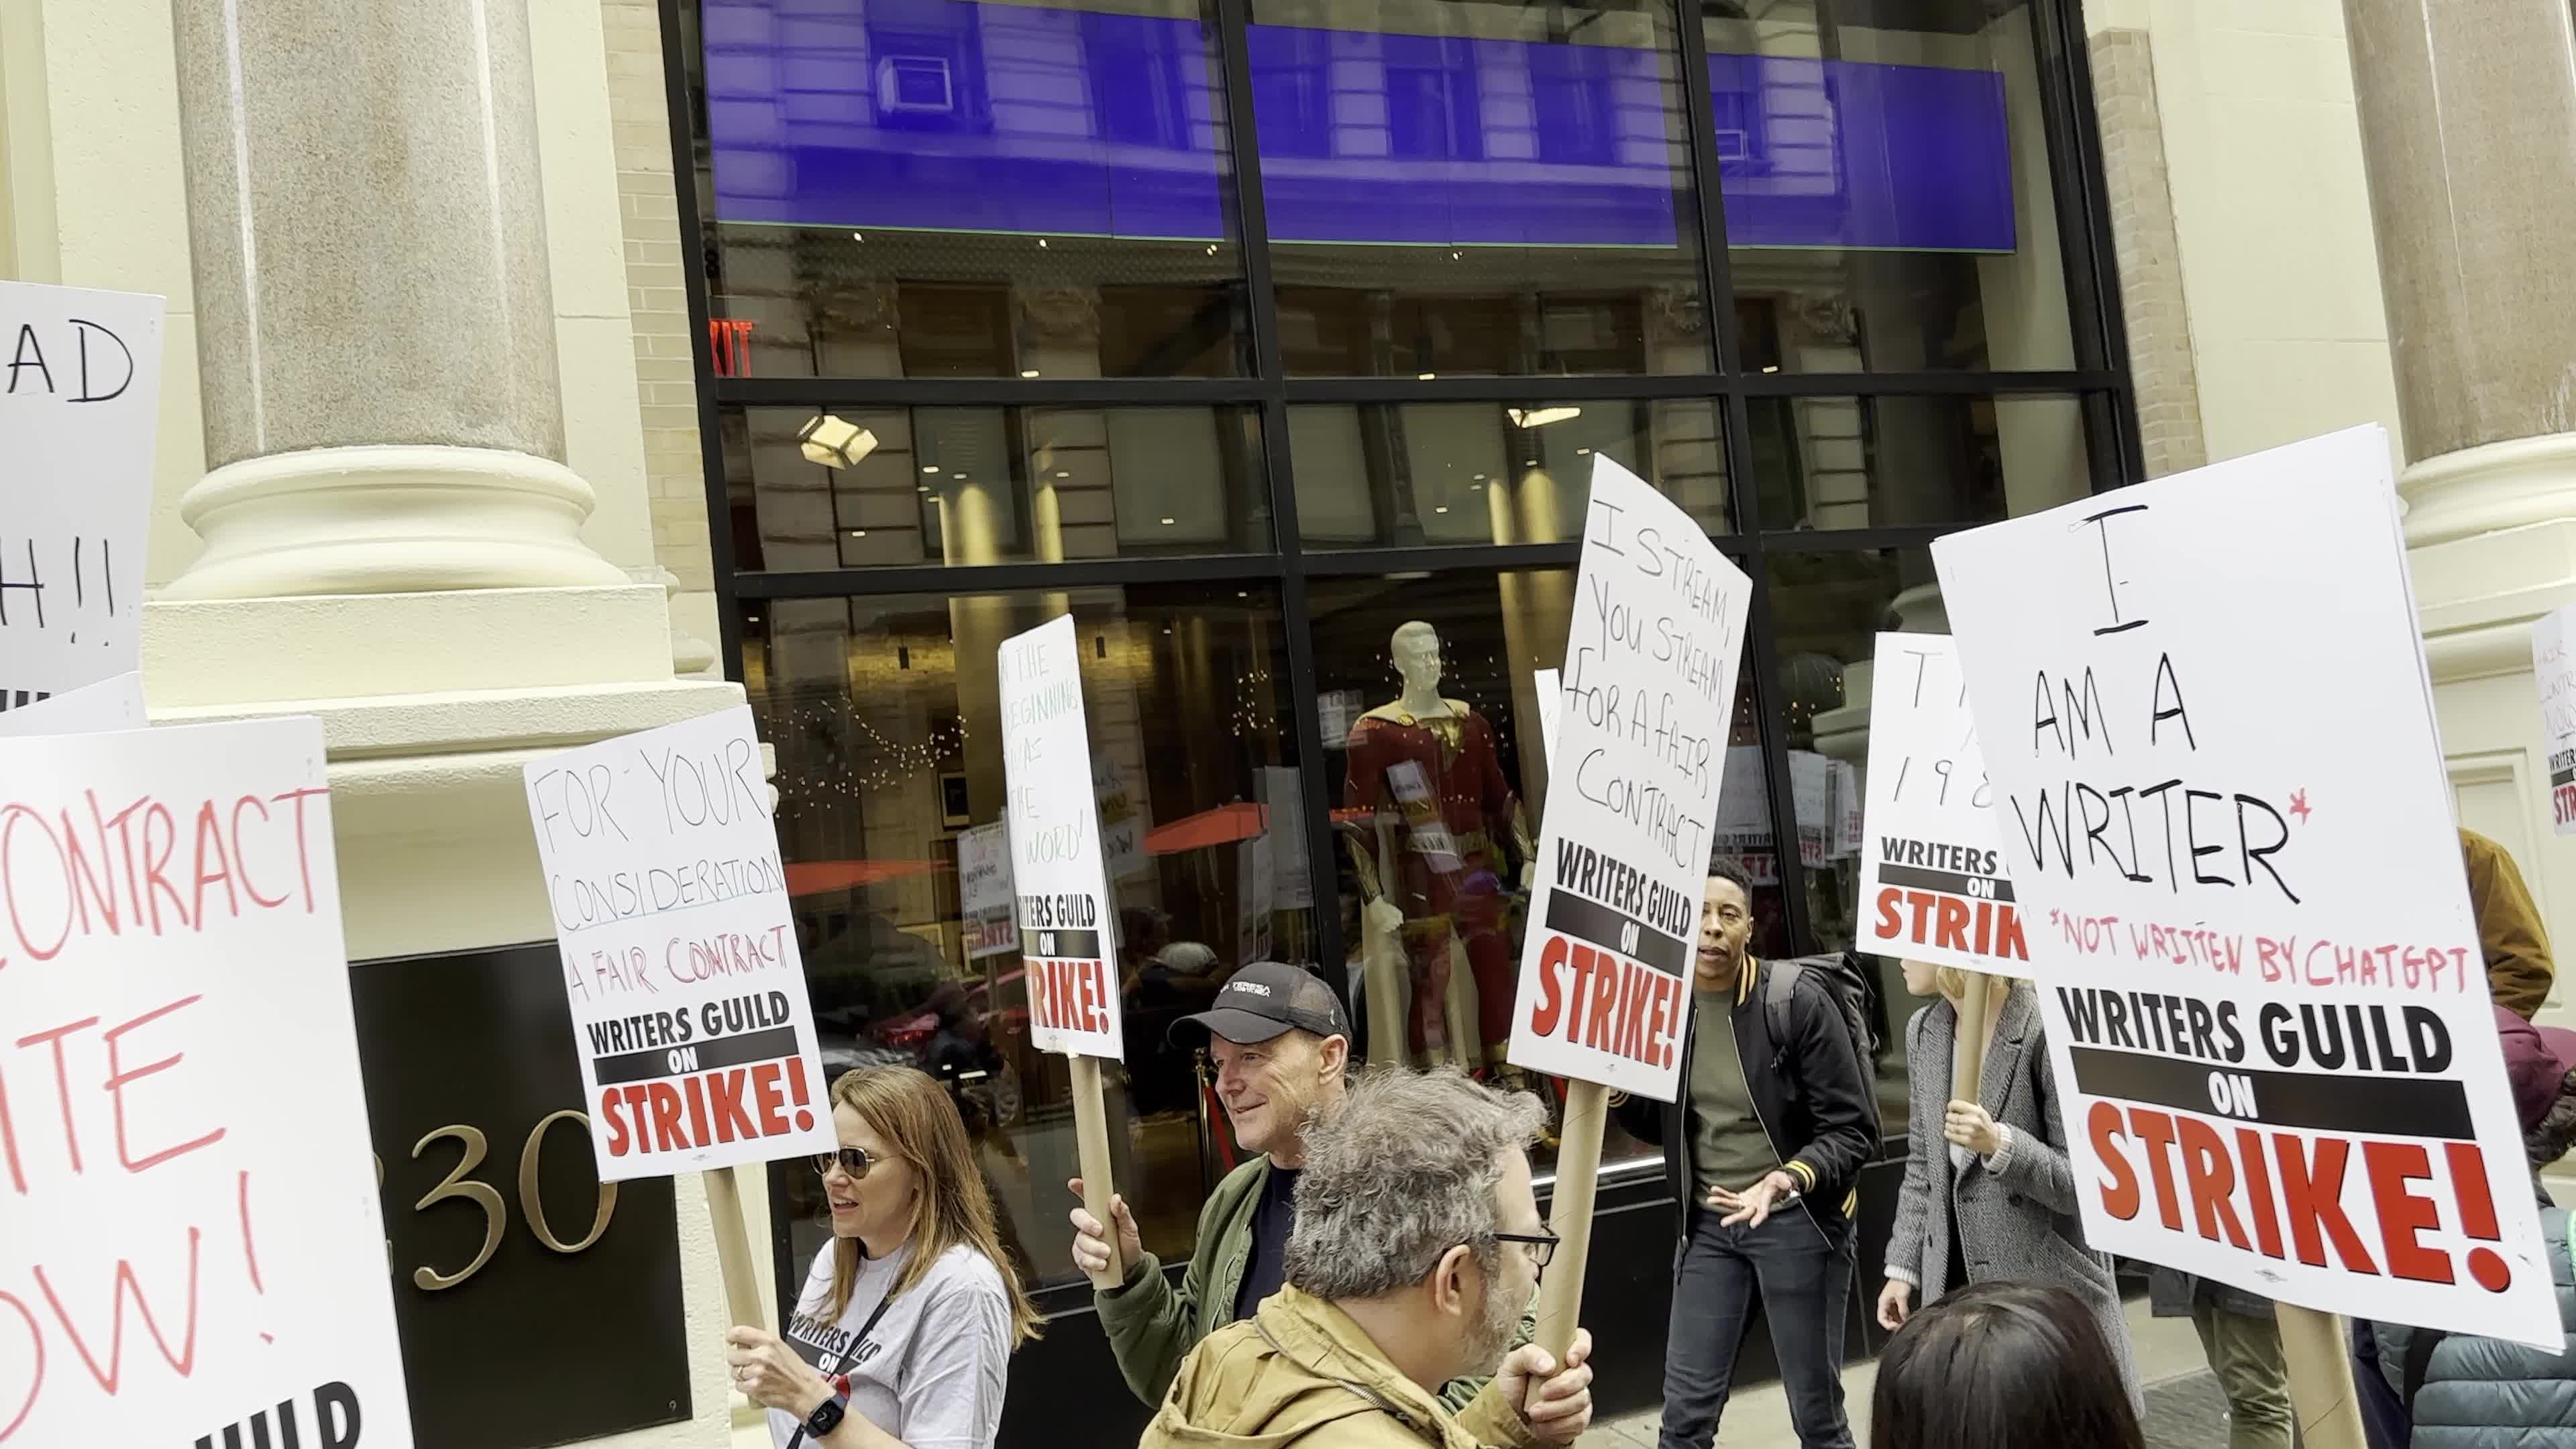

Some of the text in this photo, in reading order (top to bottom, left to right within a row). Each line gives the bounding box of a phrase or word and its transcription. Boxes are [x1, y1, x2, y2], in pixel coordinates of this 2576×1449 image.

[1591, 498, 1625, 557] I
[2069, 504, 2148, 635] I
[1590, 573, 1643, 661] YOU
[1631, 688, 1647, 747] A
[2033, 651, 2197, 761] AM A
[534, 738, 766, 854] FOR YOUR
[1576, 748, 1705, 877] CONTRACT
[0, 787, 332, 971] ONTRACT
[552, 849, 785, 931] CONSIDERATION
[1556, 837, 1691, 938] WRITERS GUILD
[1880, 836, 1998, 875] WRITERS
[1967, 876, 1995, 900] ON
[1040, 932, 1056, 956] ON
[1057, 894, 1095, 928] GUILD
[1620, 920, 1640, 957] ON
[567, 924, 788, 1004] A FAIR CONTRACT
[2129, 922, 2243, 976] WRITTEN
[2255, 934, 2297, 985] BY
[586, 990, 790, 1055] WRITERS GUILD
[1530, 934, 1683, 1071] STRIKE!
[2055, 986, 2453, 1074] WRITERS GUILD
[667, 1046, 700, 1074] ON
[2207, 1069, 2259, 1119] ON
[601, 1057, 815, 1157] STRIKE!
[374, 1109, 618, 1291] 30
[2086, 1100, 2512, 1294] STRIKE!
[789, 1310, 851, 1354] WRITERS
[818, 1352, 841, 1373] ON
